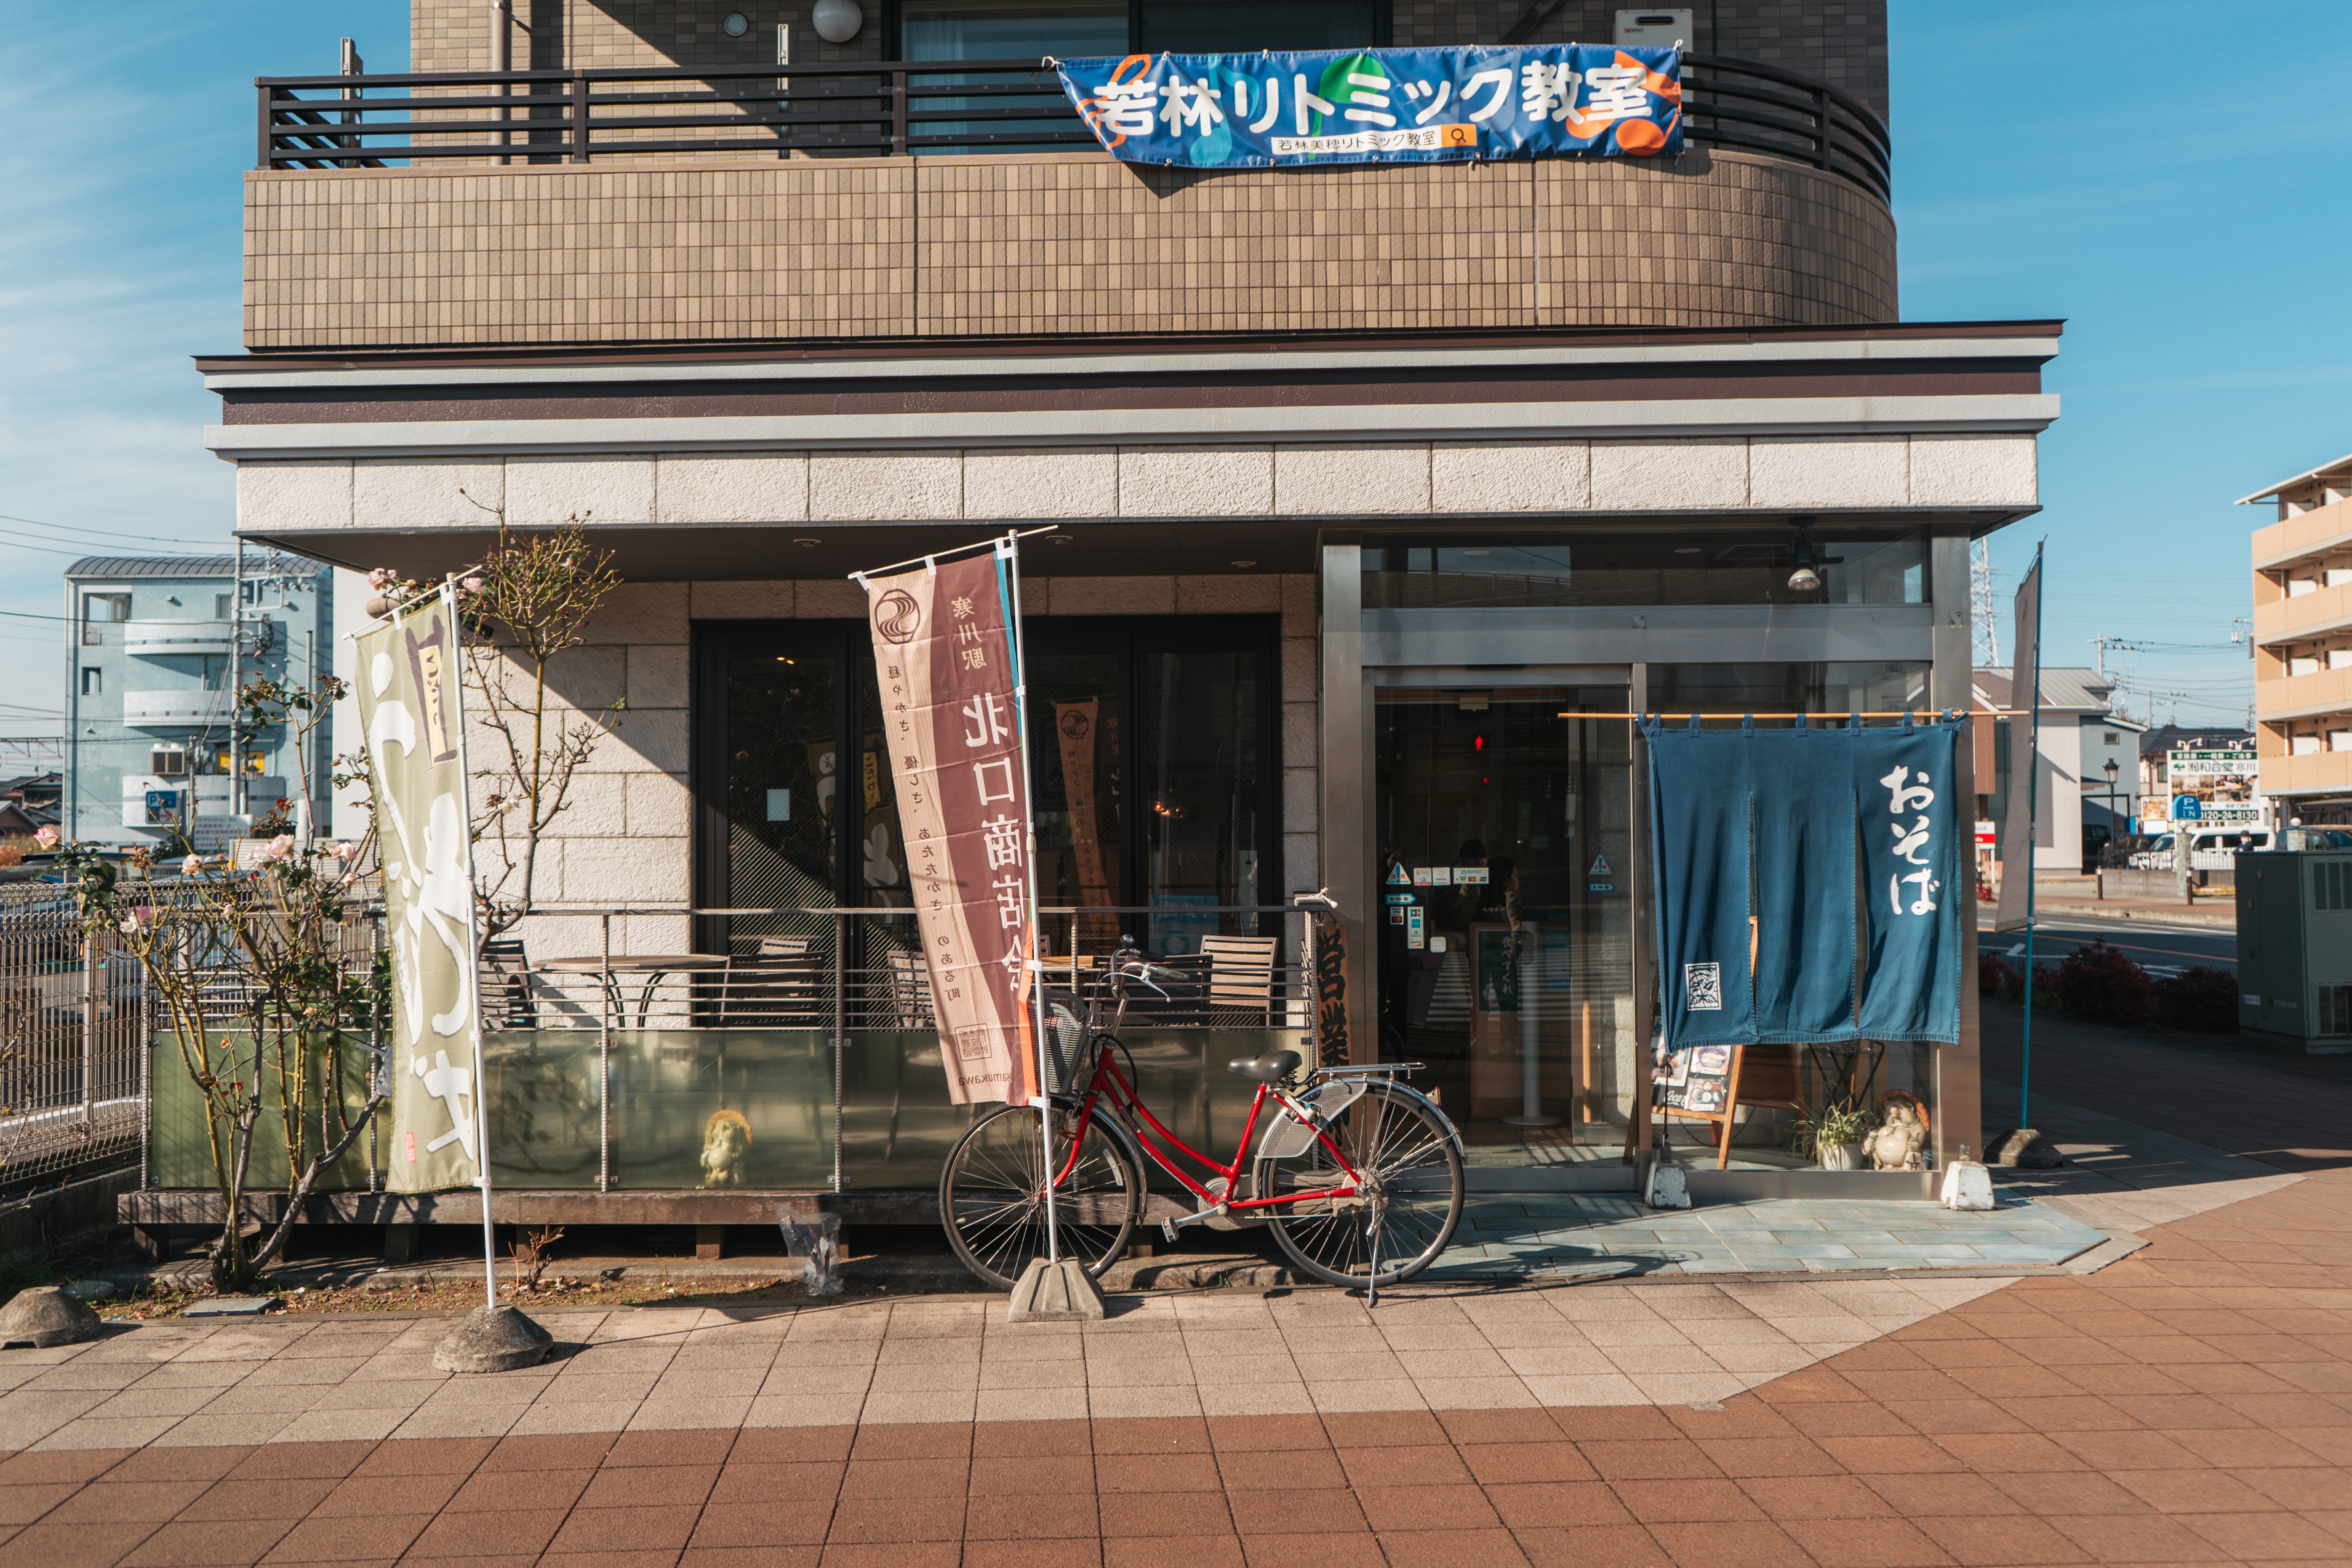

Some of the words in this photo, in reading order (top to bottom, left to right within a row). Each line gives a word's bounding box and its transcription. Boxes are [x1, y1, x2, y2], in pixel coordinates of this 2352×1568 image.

[1093, 60, 1652, 136] 若林リトミック教室
[1277, 130, 1436, 153] 若林美穂リトミック教室
[150, 795, 156, 805] P
[1880, 766, 1940, 915] おそば
